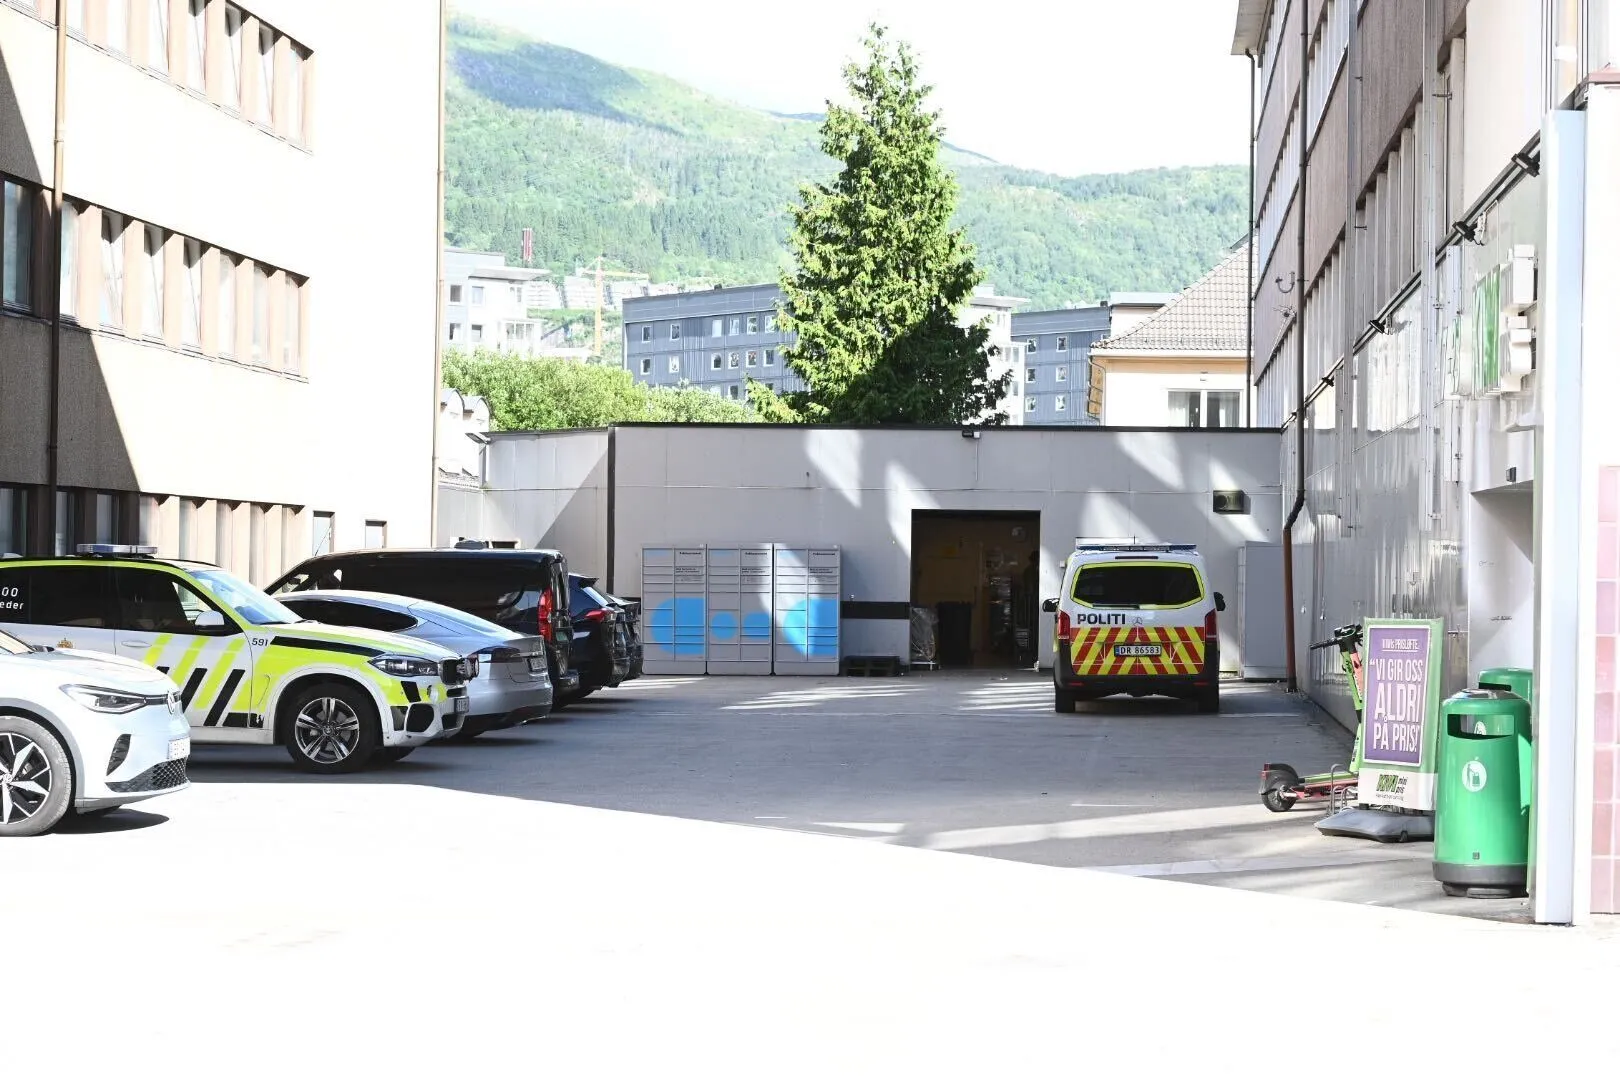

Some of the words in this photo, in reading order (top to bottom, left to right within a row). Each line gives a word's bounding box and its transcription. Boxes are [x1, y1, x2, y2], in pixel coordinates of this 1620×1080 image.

[1077, 613, 1126, 625] POLITI
[251, 637, 268, 646] 591
[1120, 646, 1132, 654] DR
[1134, 646, 1160, 655] 86583
[1387, 658, 1403, 682] GIR
[1405, 659, 1424, 682] OSS
[1374, 682, 1422, 723] ALDRI
[1373, 715, 1390, 751] PÅ
